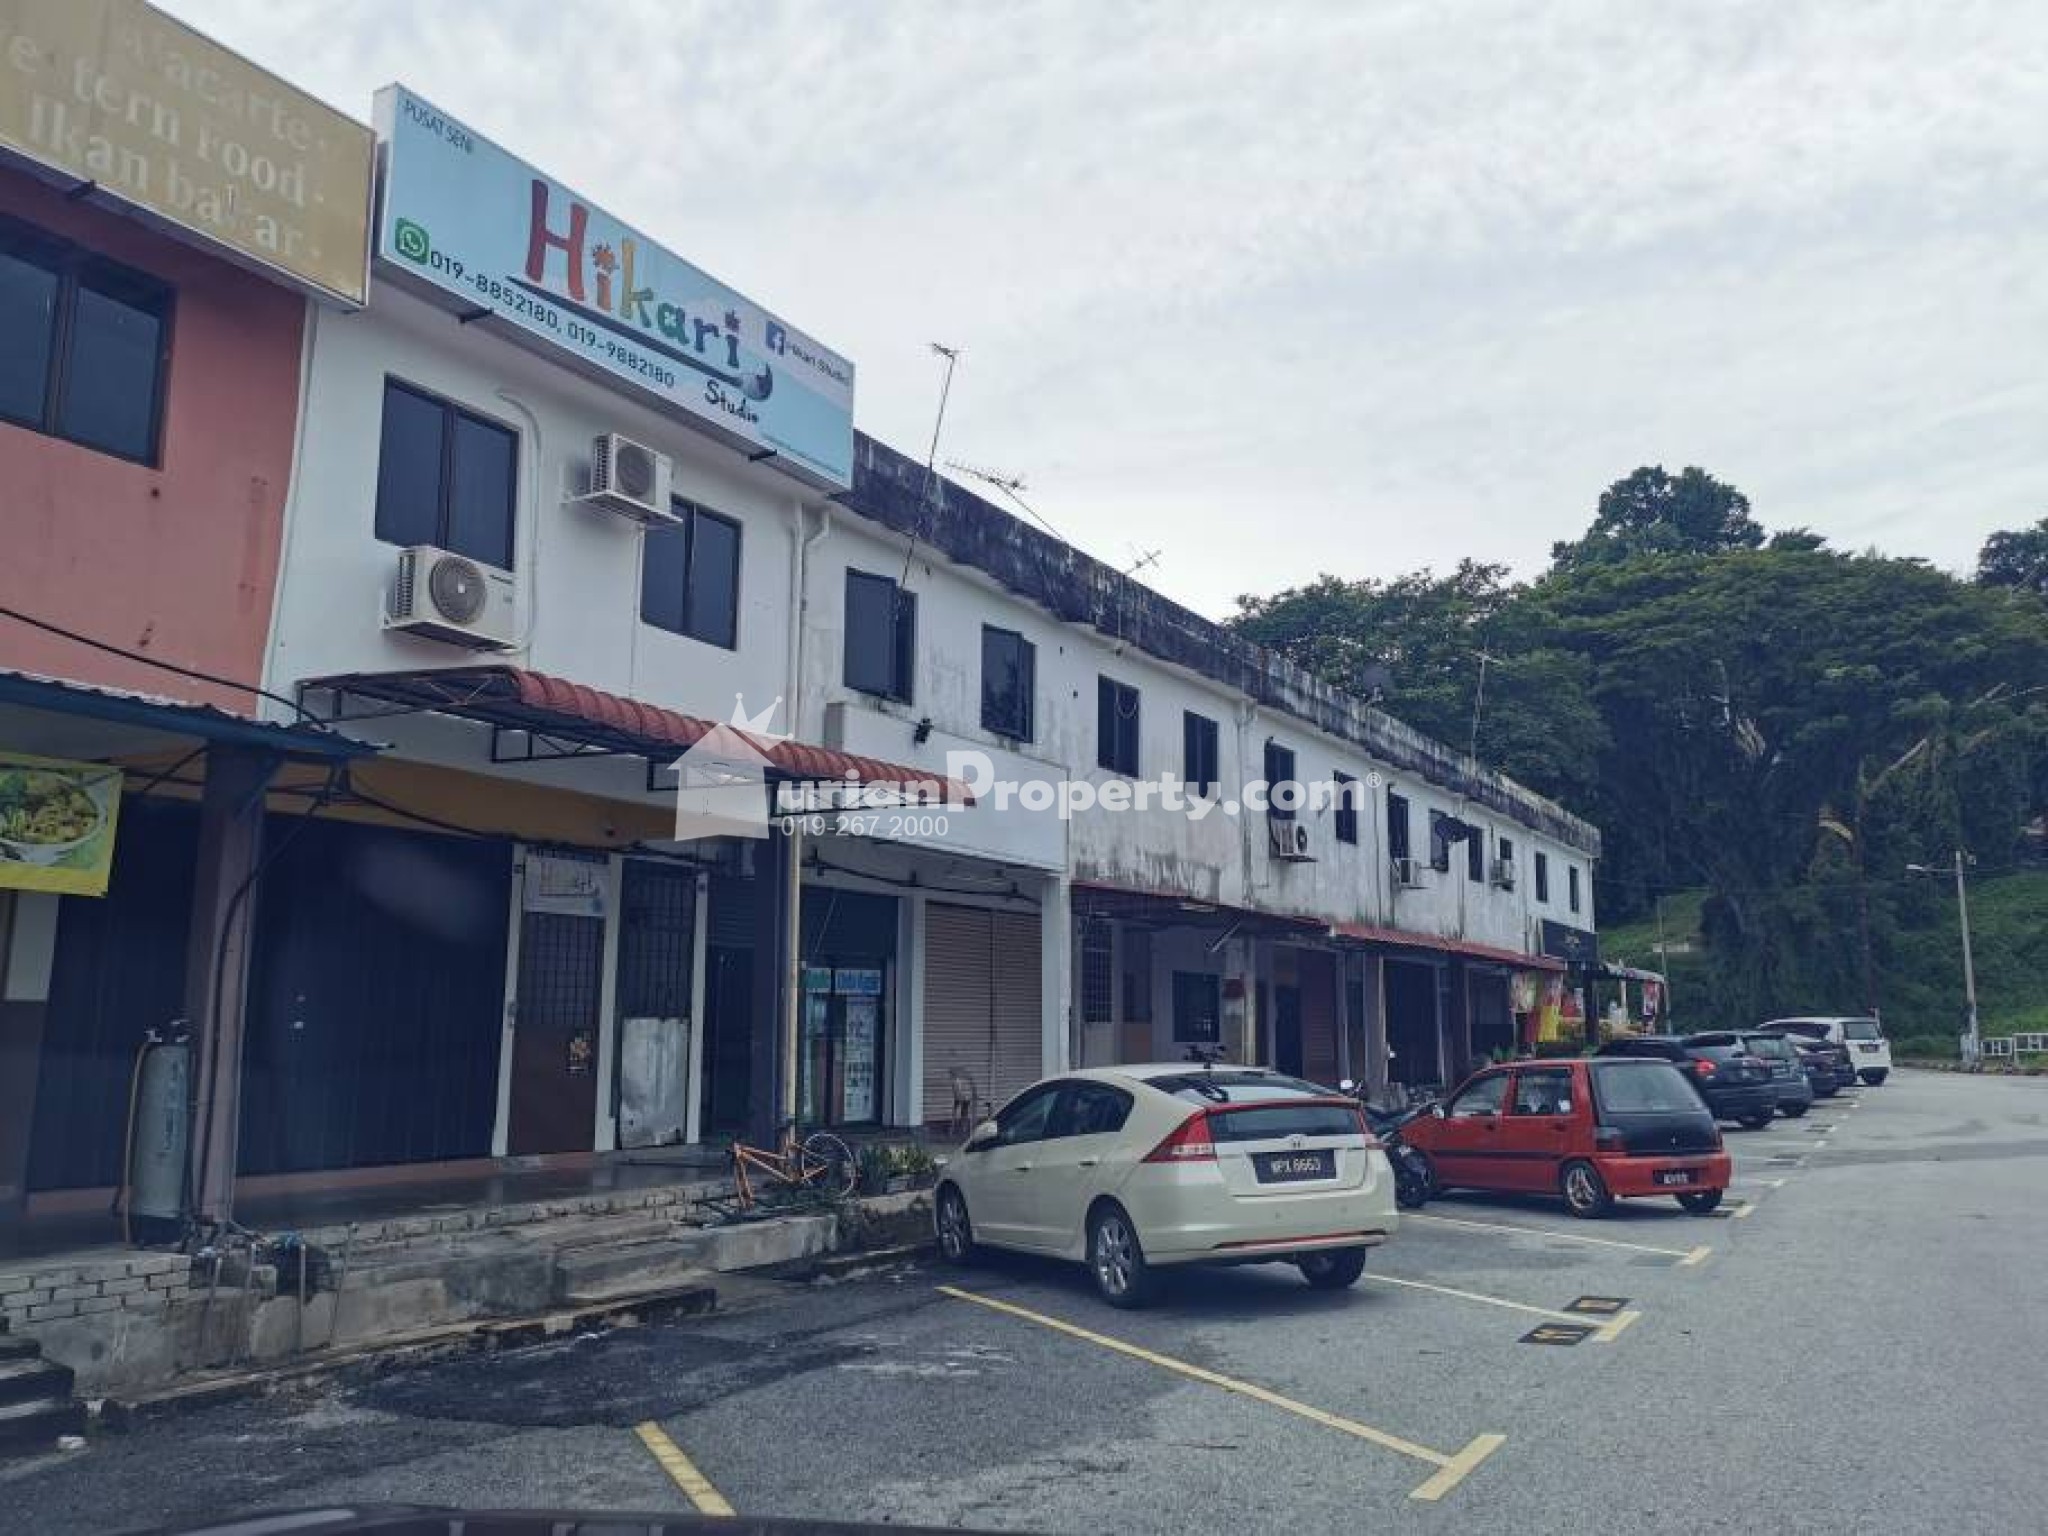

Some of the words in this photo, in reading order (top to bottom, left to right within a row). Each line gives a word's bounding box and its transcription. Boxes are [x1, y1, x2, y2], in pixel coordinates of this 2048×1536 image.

[404, 98, 443, 135] PUSAT
[525, 178, 741, 369] Hikari
[567, 321, 676, 389] 019-9882180
[704, 378, 760, 423] Studio
